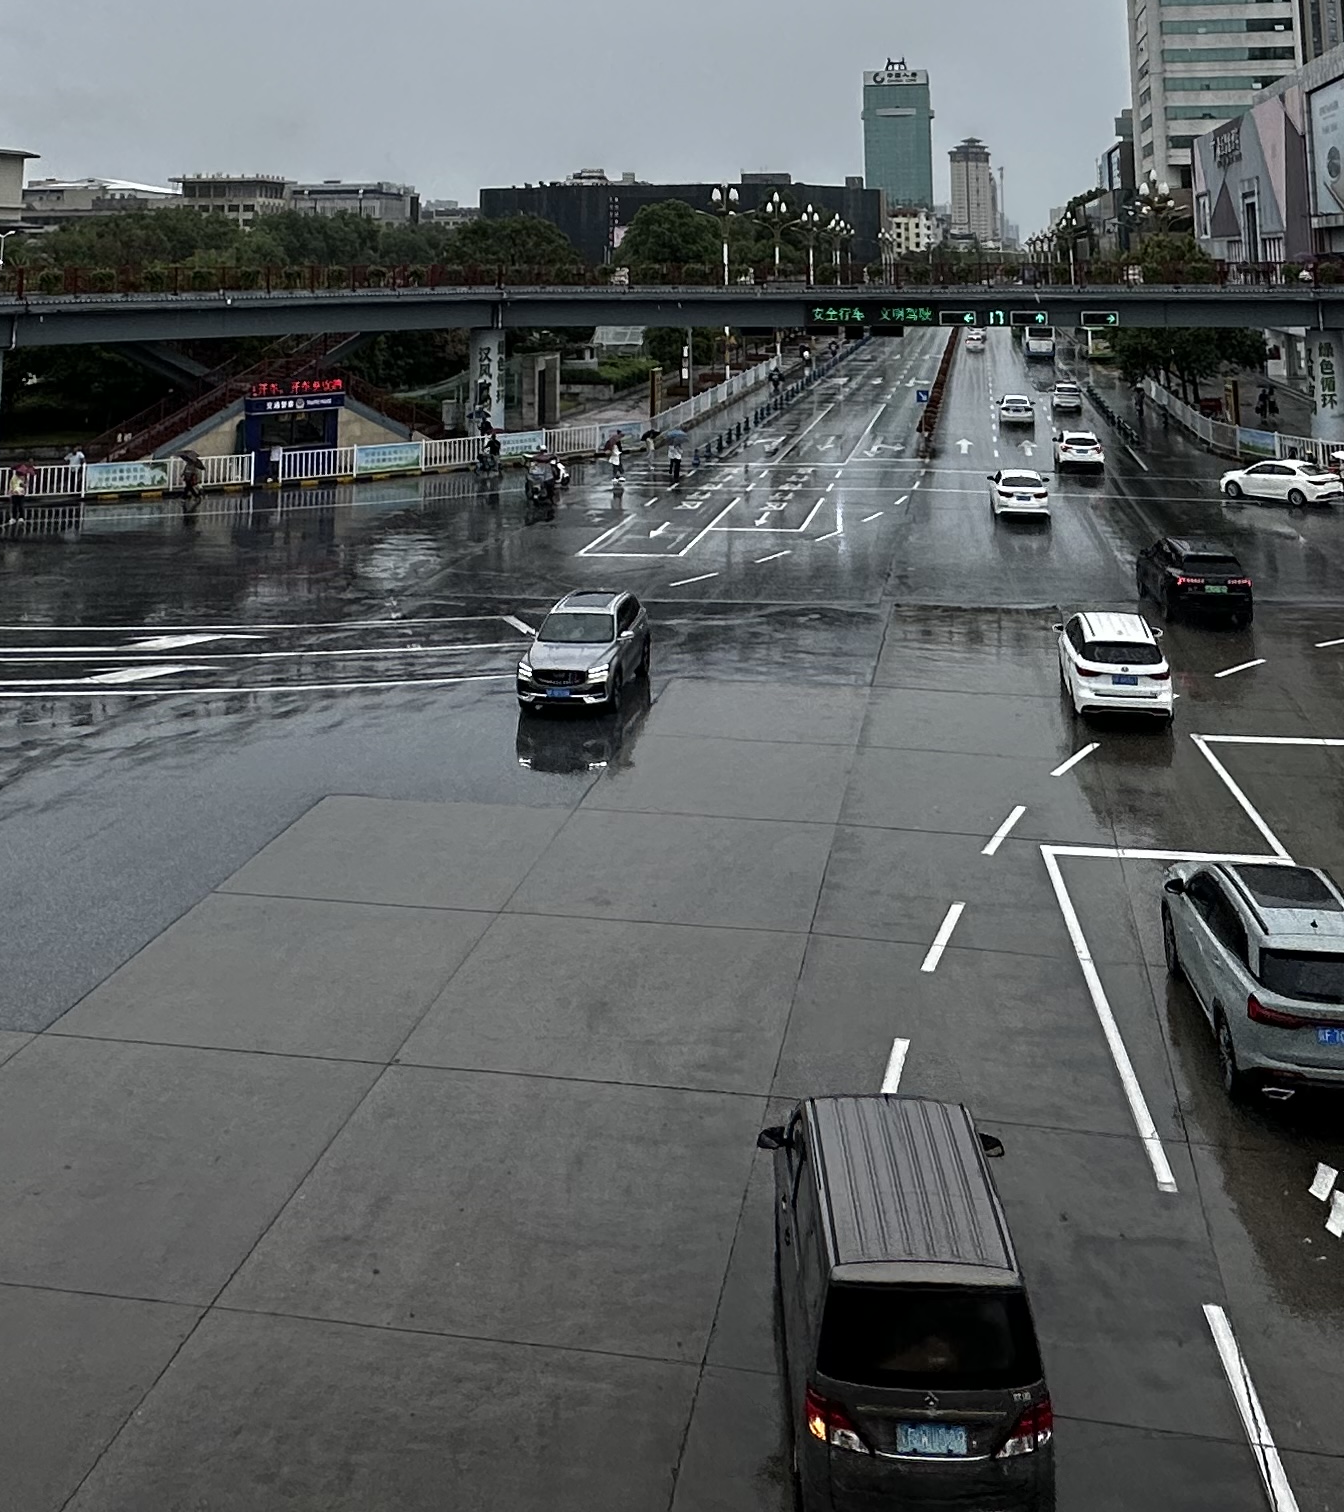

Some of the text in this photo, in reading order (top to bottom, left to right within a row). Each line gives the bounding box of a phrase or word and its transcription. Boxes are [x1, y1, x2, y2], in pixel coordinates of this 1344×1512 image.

[812, 306, 933, 322] 安全行车 文明驾驶
